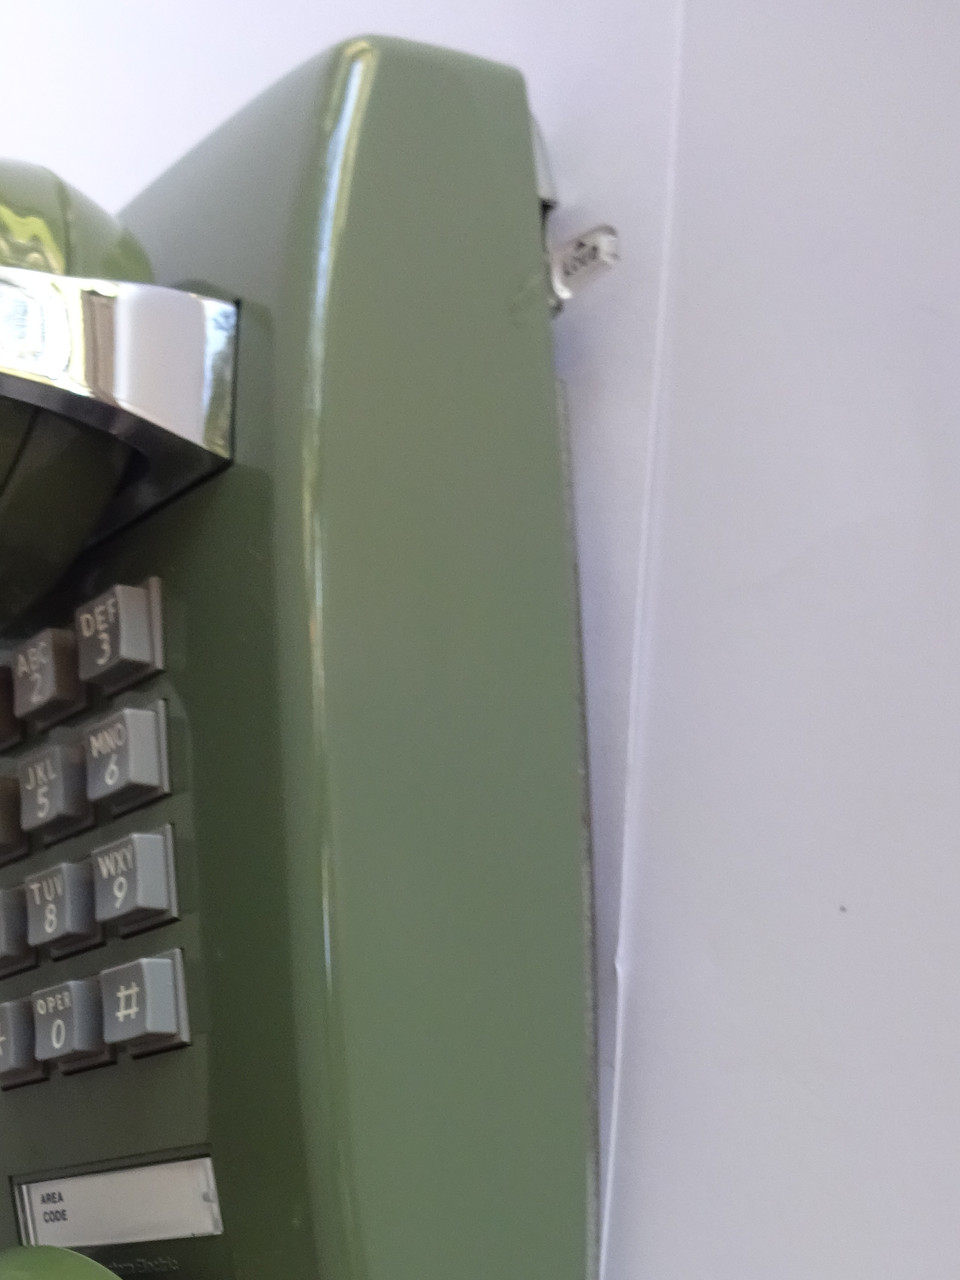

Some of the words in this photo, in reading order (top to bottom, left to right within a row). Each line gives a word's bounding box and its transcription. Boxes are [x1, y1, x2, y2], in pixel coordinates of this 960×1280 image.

[79, 598, 117, 638] DEF
[96, 631, 112, 666] 3
[89, 722, 127, 758] MNO
[25, 759, 56, 790] JKL
[104, 752, 121, 786] 6
[35, 785, 50, 818] 5
[97, 844, 134, 879] WXY
[30, 876, 63, 905] TUV
[113, 876, 129, 909] 9
[44, 903, 58, 934] 8
[40, 1191, 65, 1204] AREA
[43, 1209, 68, 1223] CODE
